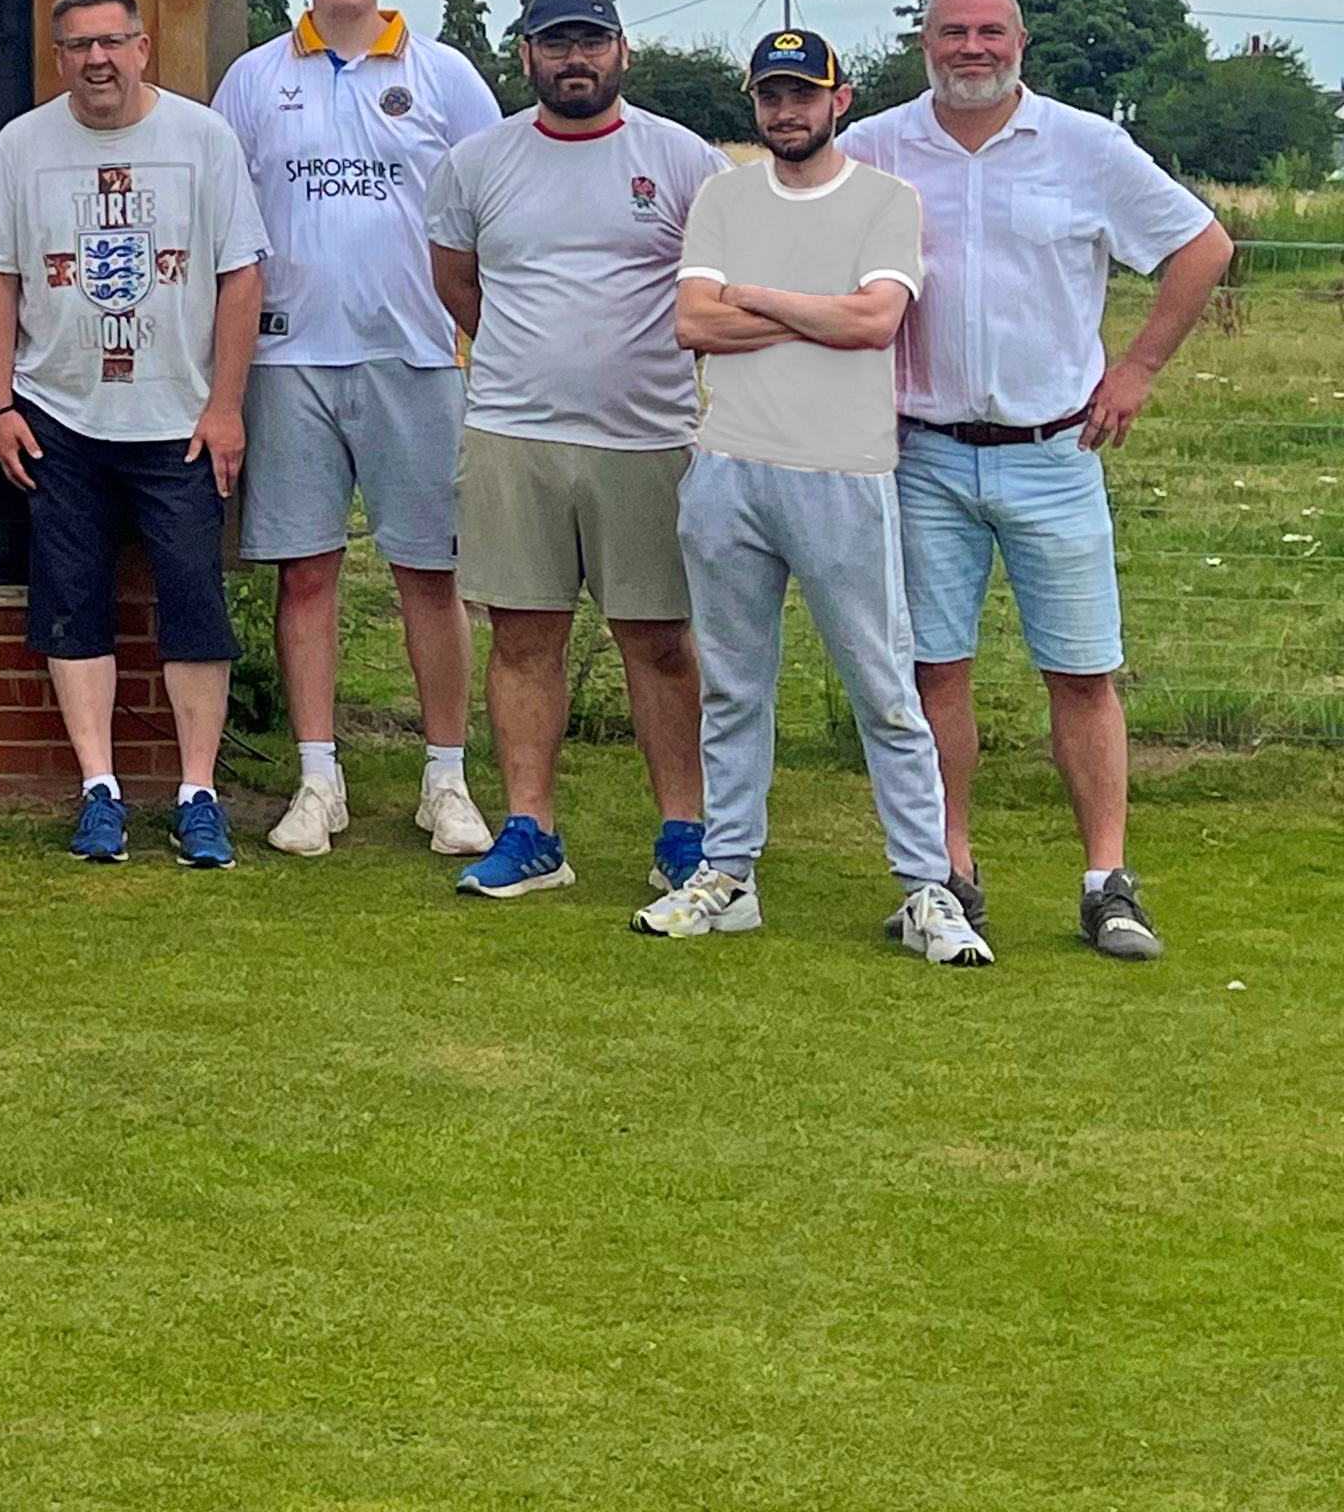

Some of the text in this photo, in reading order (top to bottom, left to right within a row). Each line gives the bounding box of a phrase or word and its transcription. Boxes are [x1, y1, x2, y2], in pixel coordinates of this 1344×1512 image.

[306, 178, 388, 202] HOMES
[72, 189, 157, 228] THREE
[76, 314, 157, 350] LIONS
